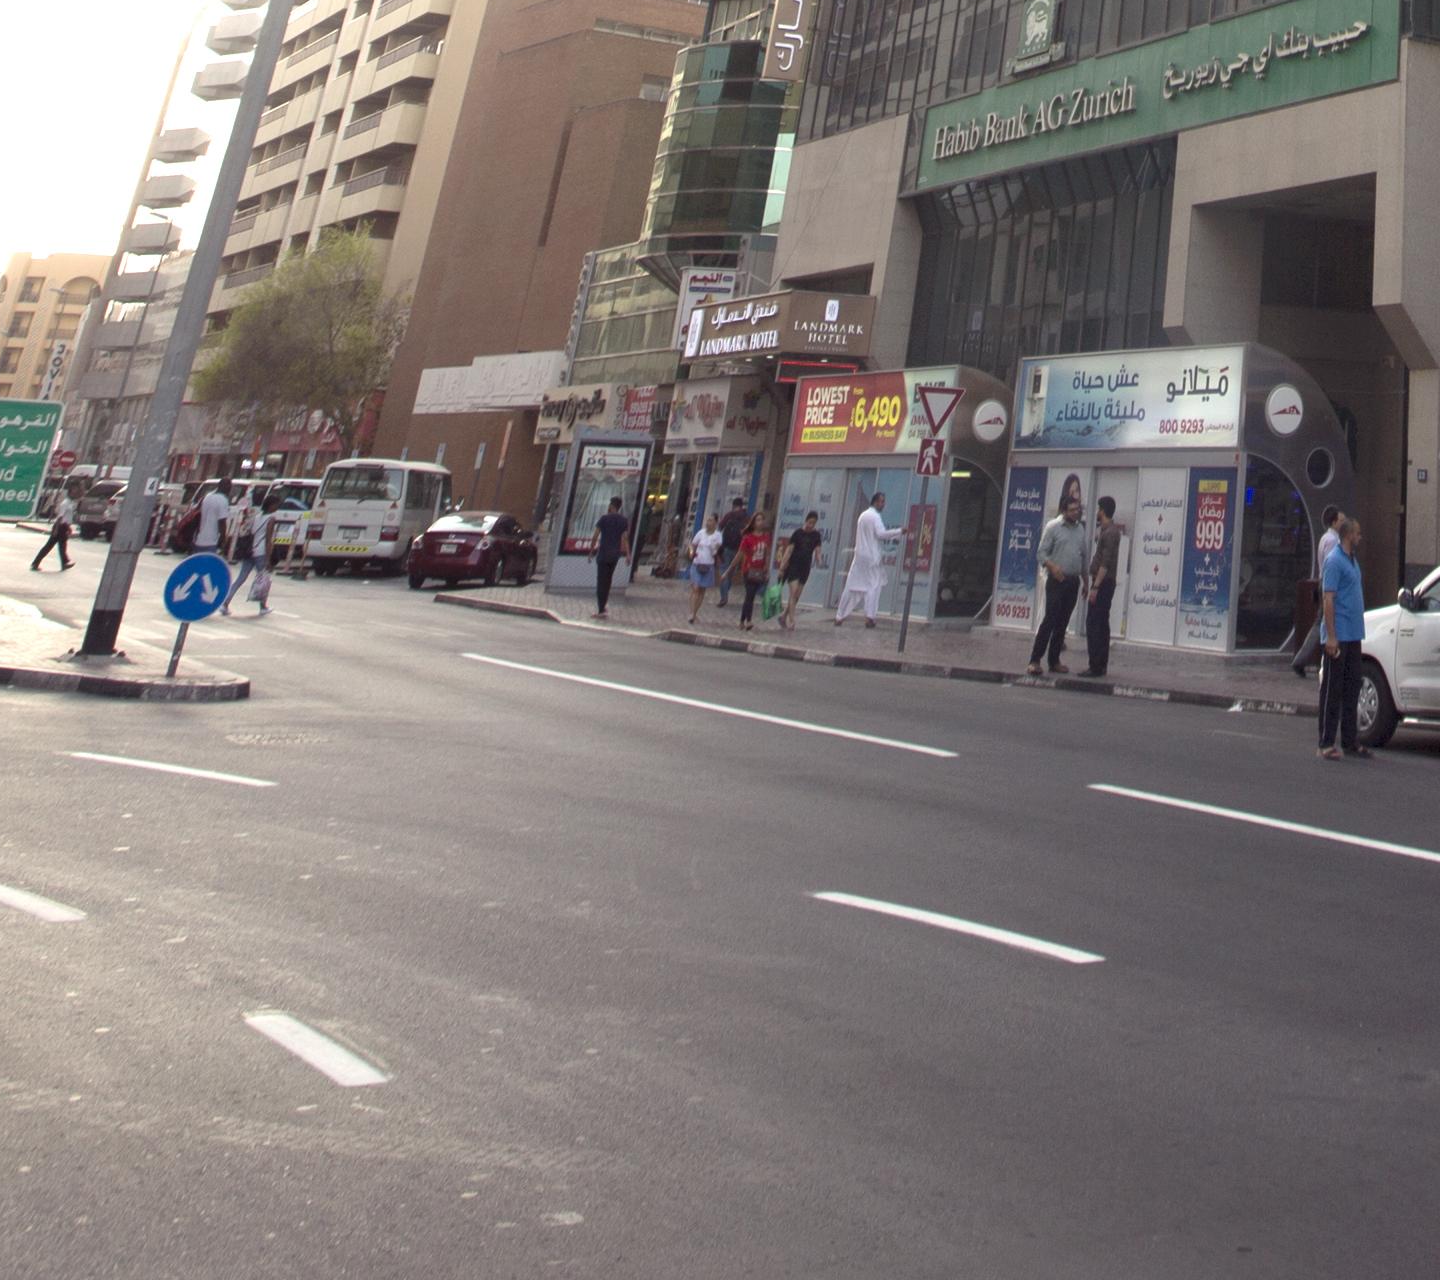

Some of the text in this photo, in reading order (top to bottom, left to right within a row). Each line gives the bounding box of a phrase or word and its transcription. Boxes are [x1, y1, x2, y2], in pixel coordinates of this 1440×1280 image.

[1275, 26, 1311, 59] بنك
[1313, 20, 1369, 51] حبيب
[932, 76, 1137, 161] Habib Bank AG Zurich
[793, 320, 864, 335] LANDMARK
[807, 332, 848, 345] HOTEL
[749, 330, 780, 350] HOTEL
[1072, 364, 1140, 392] عش حياة
[807, 386, 850, 405] LOWEST
[804, 407, 834, 425] PRICE
[854, 395, 901, 433] 6,490
[1056, 397, 1145, 424] مليئة بالنقاء
[1159, 418, 1204, 434] 800 9293
[1195, 521, 1225, 550] 999
[1012, 605, 1031, 620] 9293
